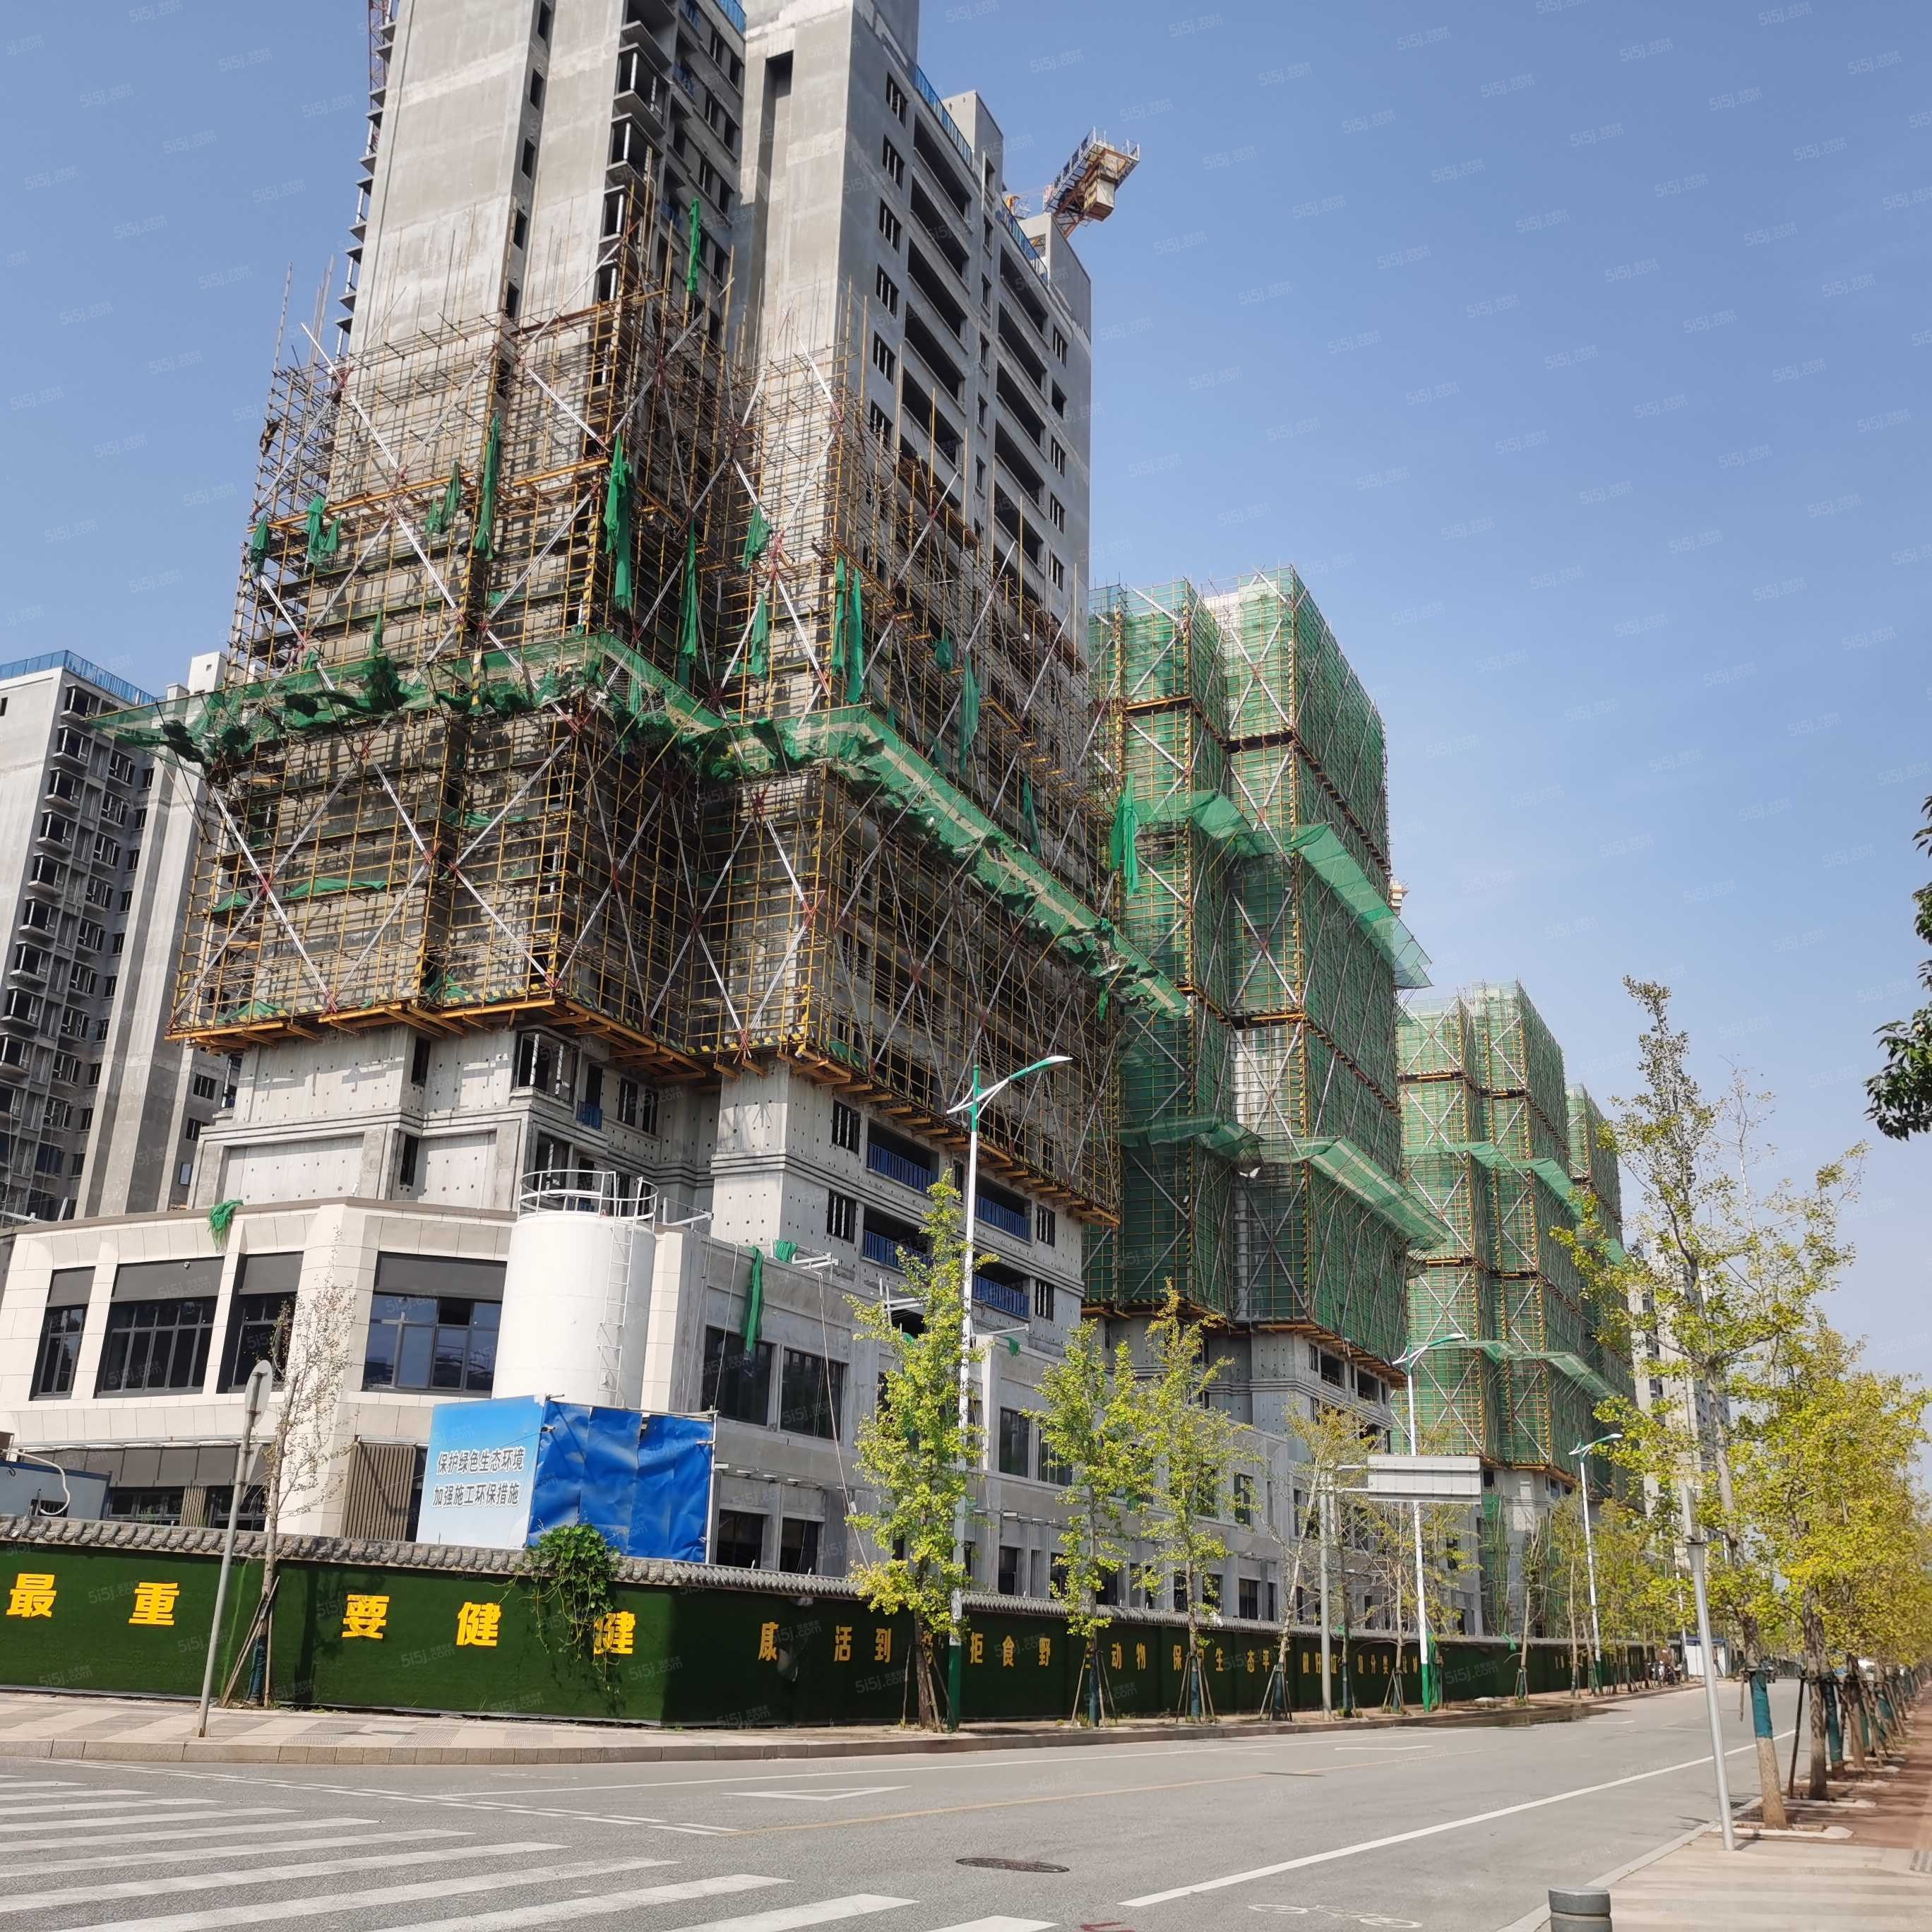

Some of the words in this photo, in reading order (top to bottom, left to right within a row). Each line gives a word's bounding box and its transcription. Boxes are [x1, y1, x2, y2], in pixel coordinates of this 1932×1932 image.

[437, 1446, 525, 1474] 保护绿色生态环境
[432, 1481, 520, 1506] 加强施工环保措施
